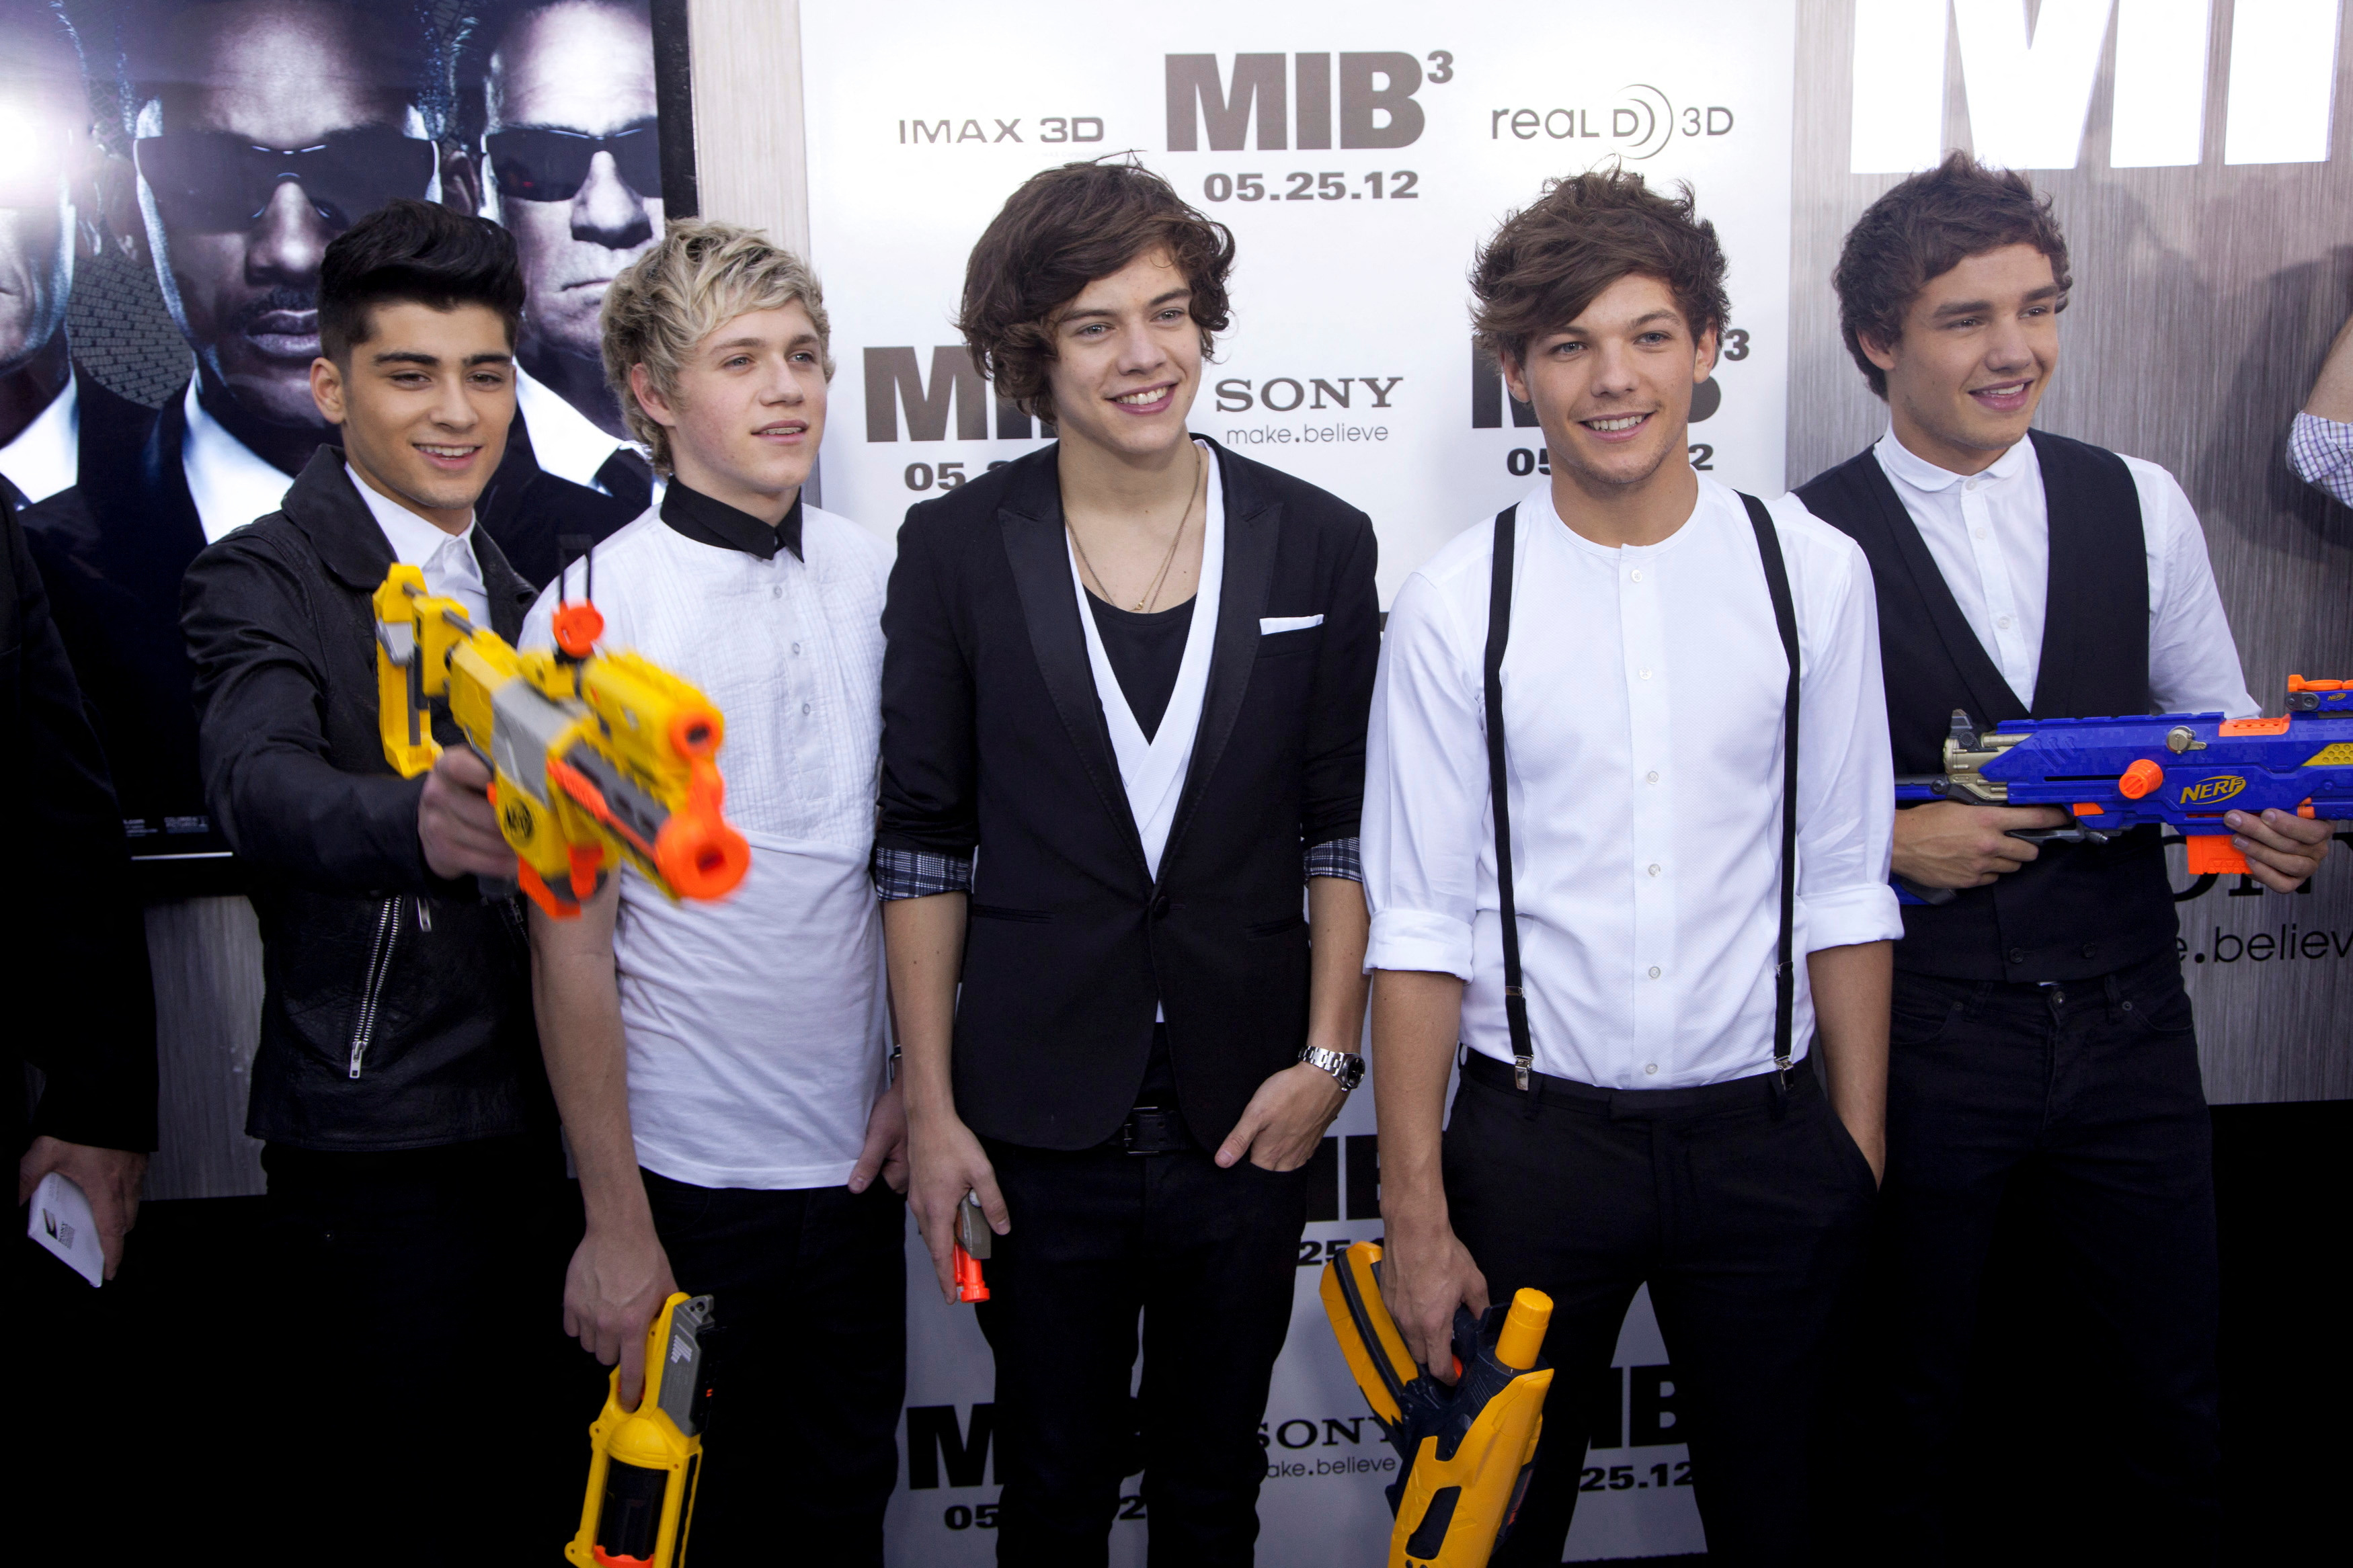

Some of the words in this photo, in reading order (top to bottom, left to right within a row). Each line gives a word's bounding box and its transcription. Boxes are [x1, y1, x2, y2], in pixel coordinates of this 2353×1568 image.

[899, 118, 1024, 144] IMAX
[1040, 117, 1105, 143] 3D
[1681, 106, 1734, 137] 3D
[1203, 171, 1419, 202] 05.25.12
[1215, 376, 1404, 413] SONY
[1227, 423, 1389, 444] make.believe
[2180, 776, 2246, 804] NERF
[1267, 1456, 1396, 1479] ake.believe
